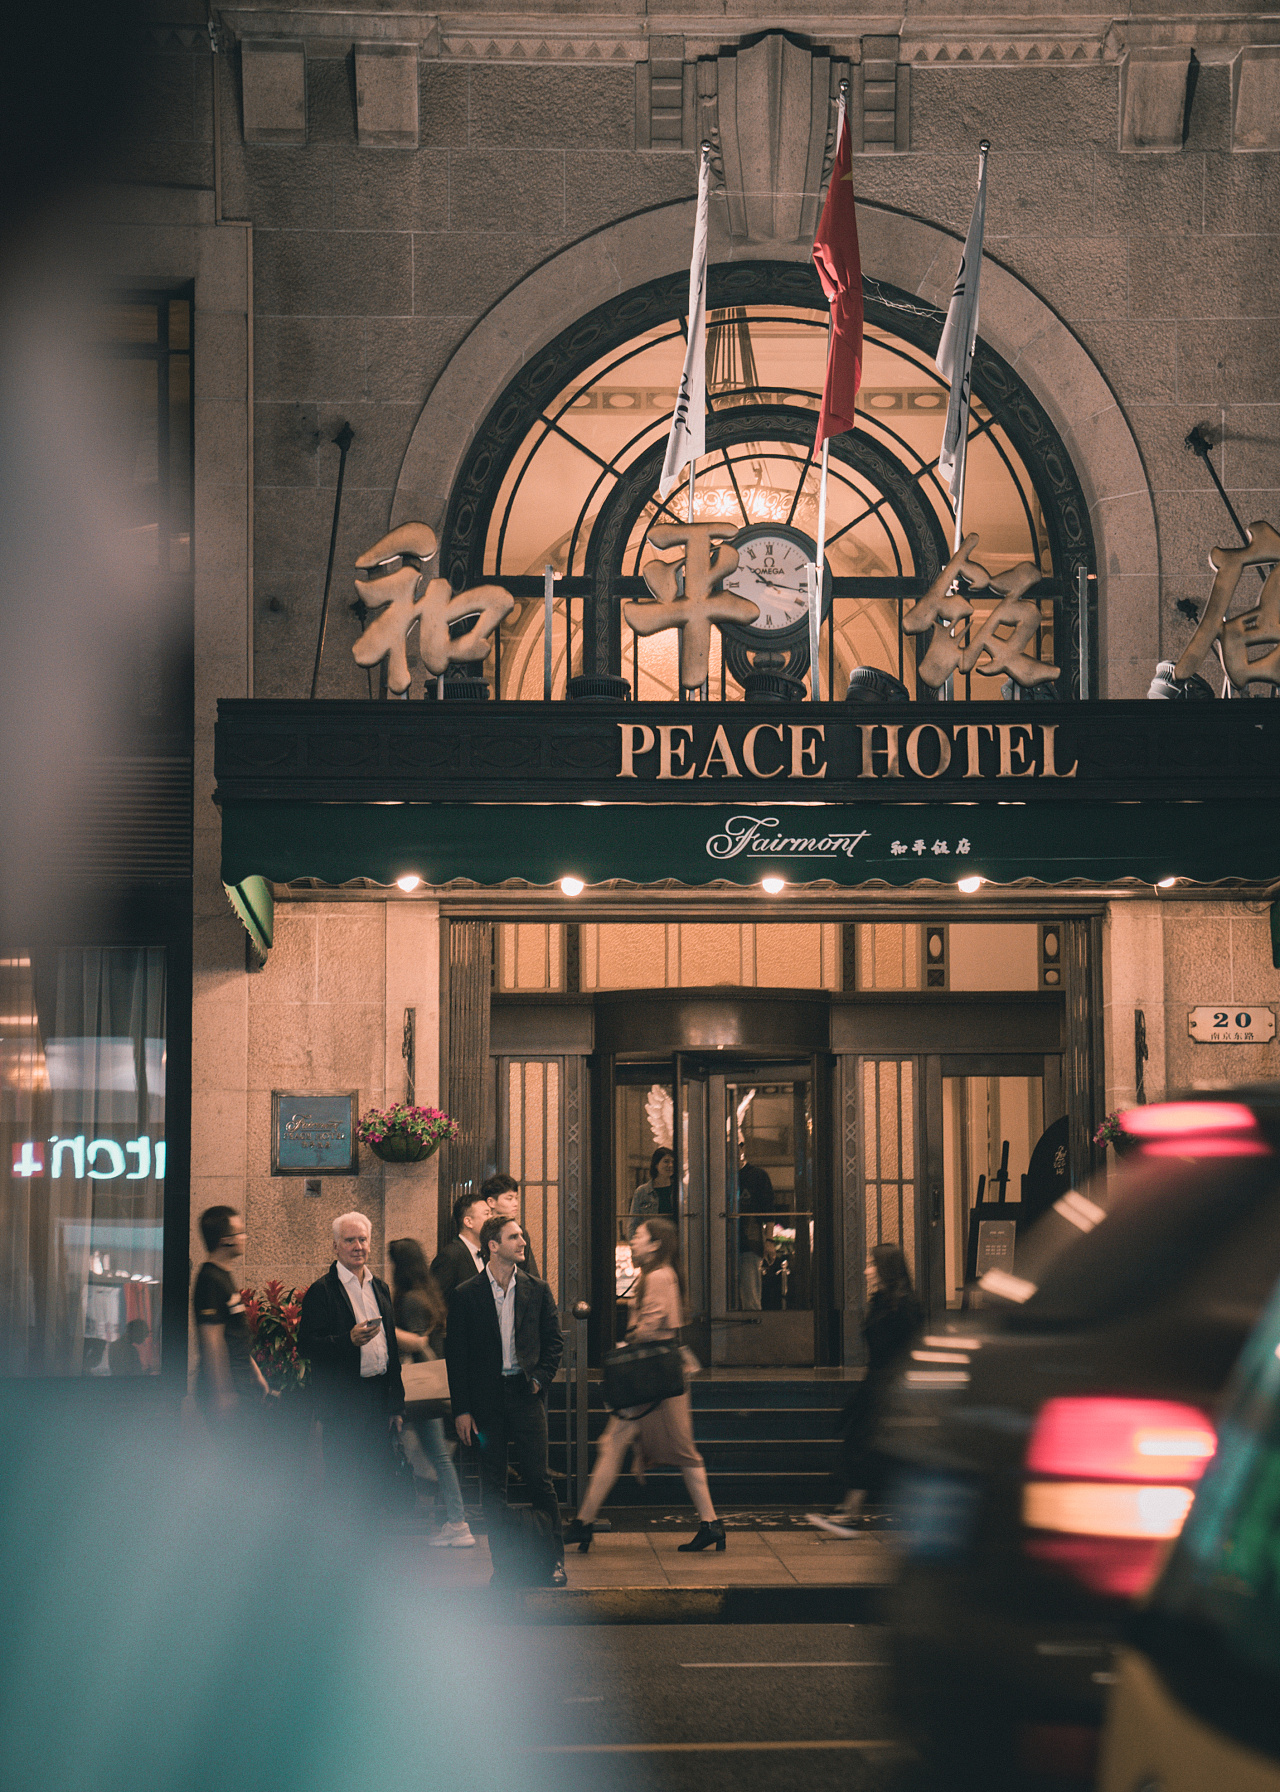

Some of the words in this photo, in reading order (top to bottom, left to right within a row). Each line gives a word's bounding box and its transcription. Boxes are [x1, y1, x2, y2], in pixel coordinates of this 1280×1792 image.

[616, 723, 828, 780] PEACE
[856, 723, 1079, 780] HOTEL
[705, 815, 872, 859] Fairmont
[1213, 1012, 1252, 1029] 20
[1210, 1032, 1255, 1041] 南京东路
